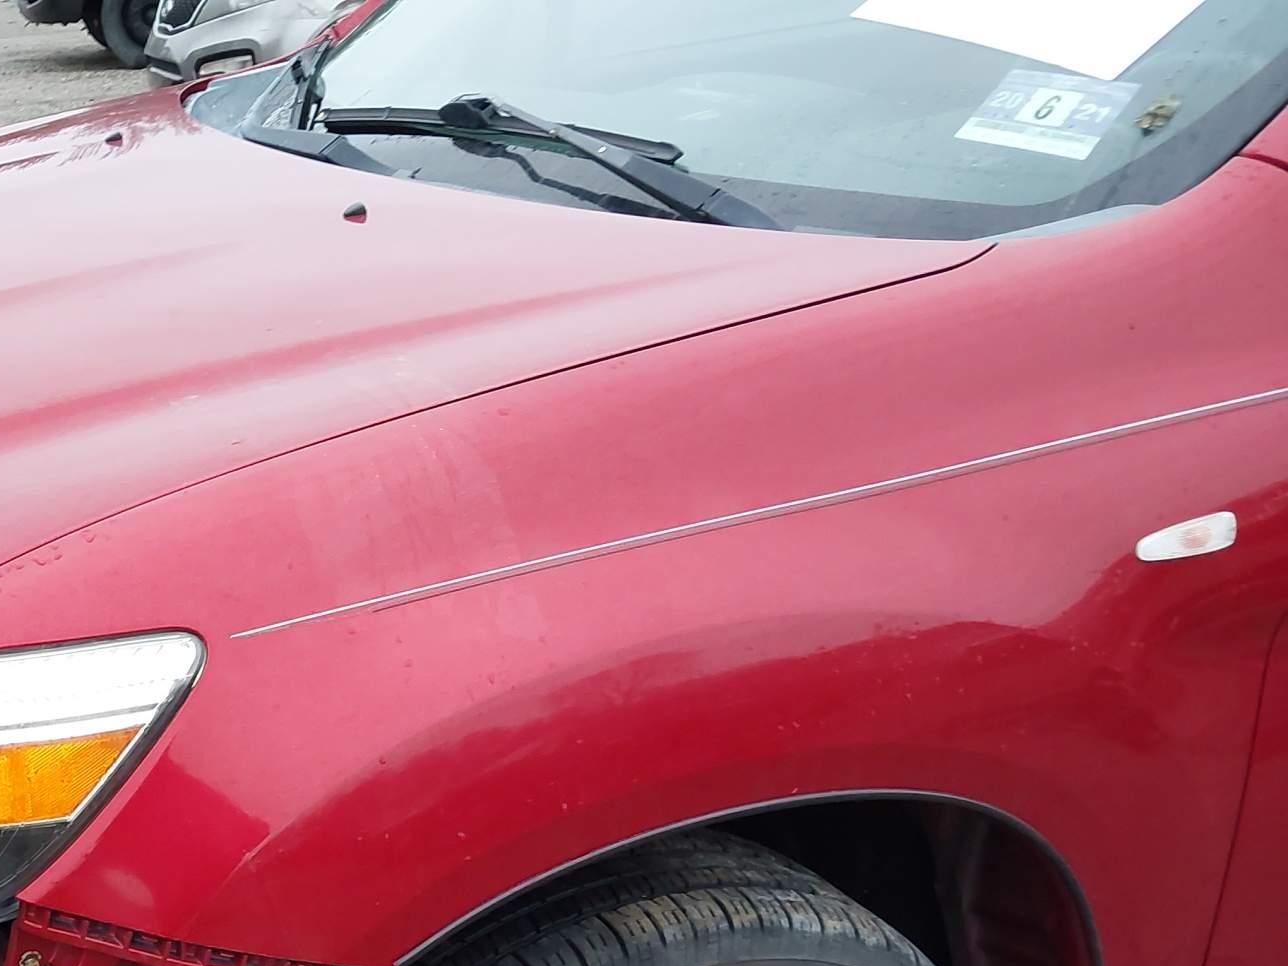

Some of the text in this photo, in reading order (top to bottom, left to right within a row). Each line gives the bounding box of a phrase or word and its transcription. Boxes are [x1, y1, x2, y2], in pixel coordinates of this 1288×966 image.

[989, 90, 1113, 123] 20 6 21
